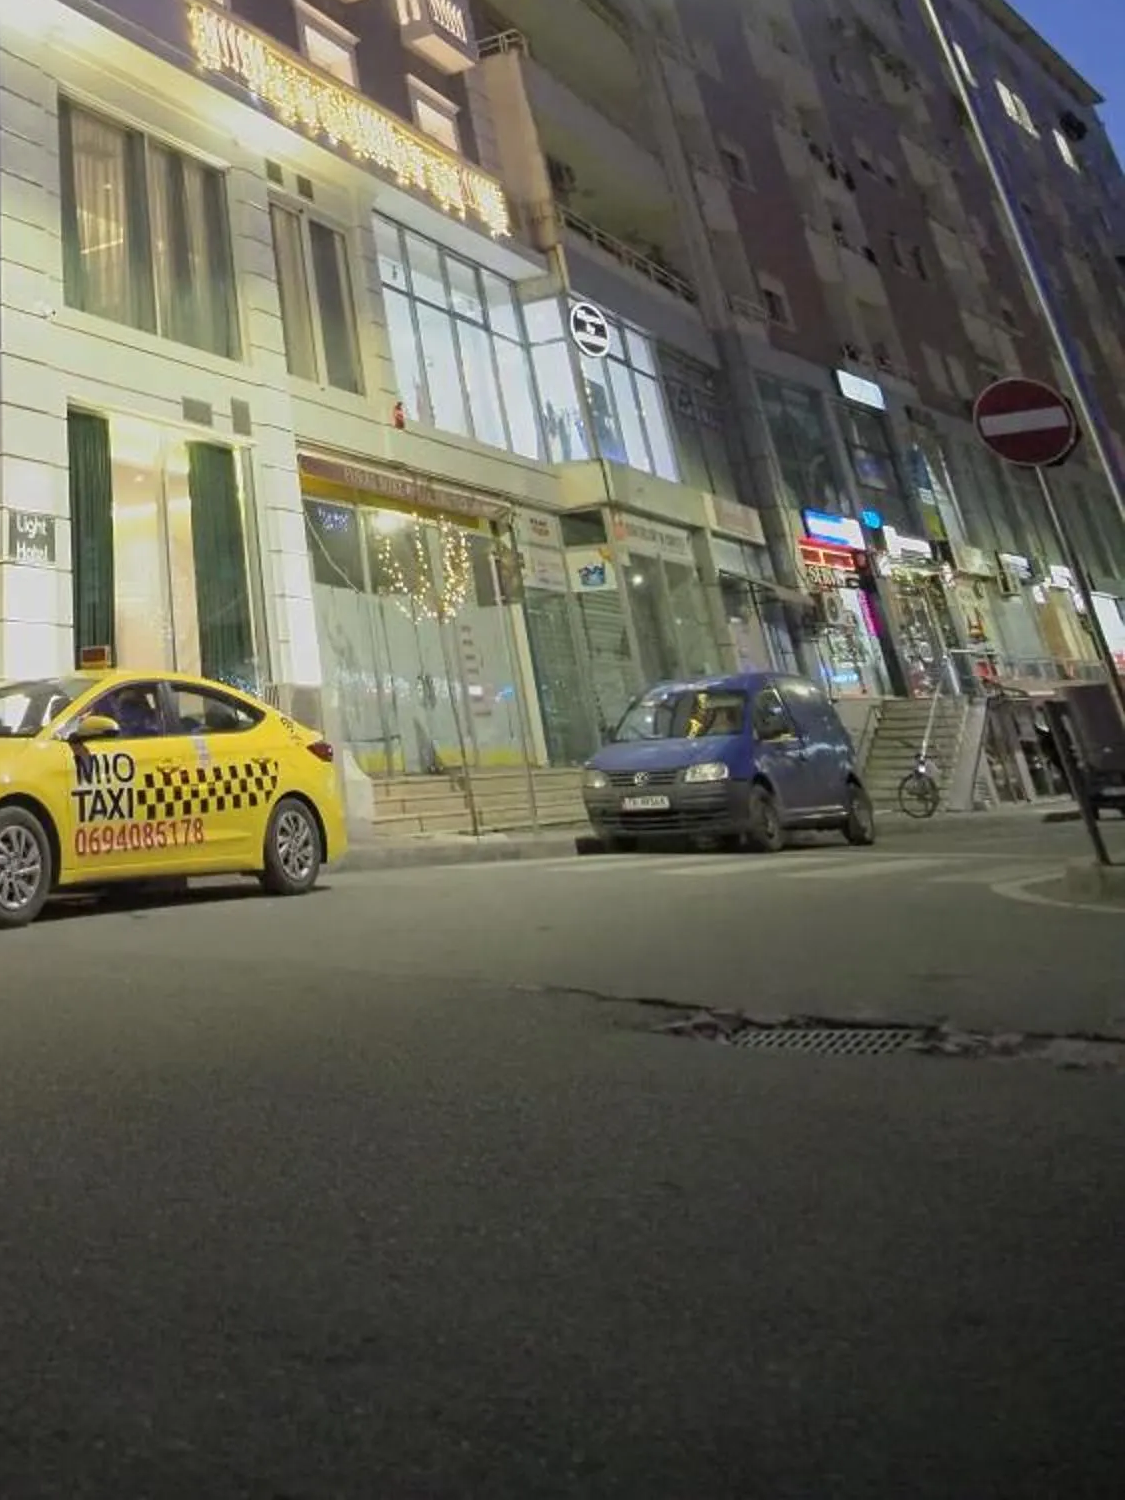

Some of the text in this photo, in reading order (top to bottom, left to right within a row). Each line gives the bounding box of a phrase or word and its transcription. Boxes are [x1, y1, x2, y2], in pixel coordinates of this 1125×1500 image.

[16, 514, 48, 539] Light
[16, 540, 48, 561] Hotel
[71, 787, 134, 823] TAXI
[75, 817, 204, 856] 0694085178
